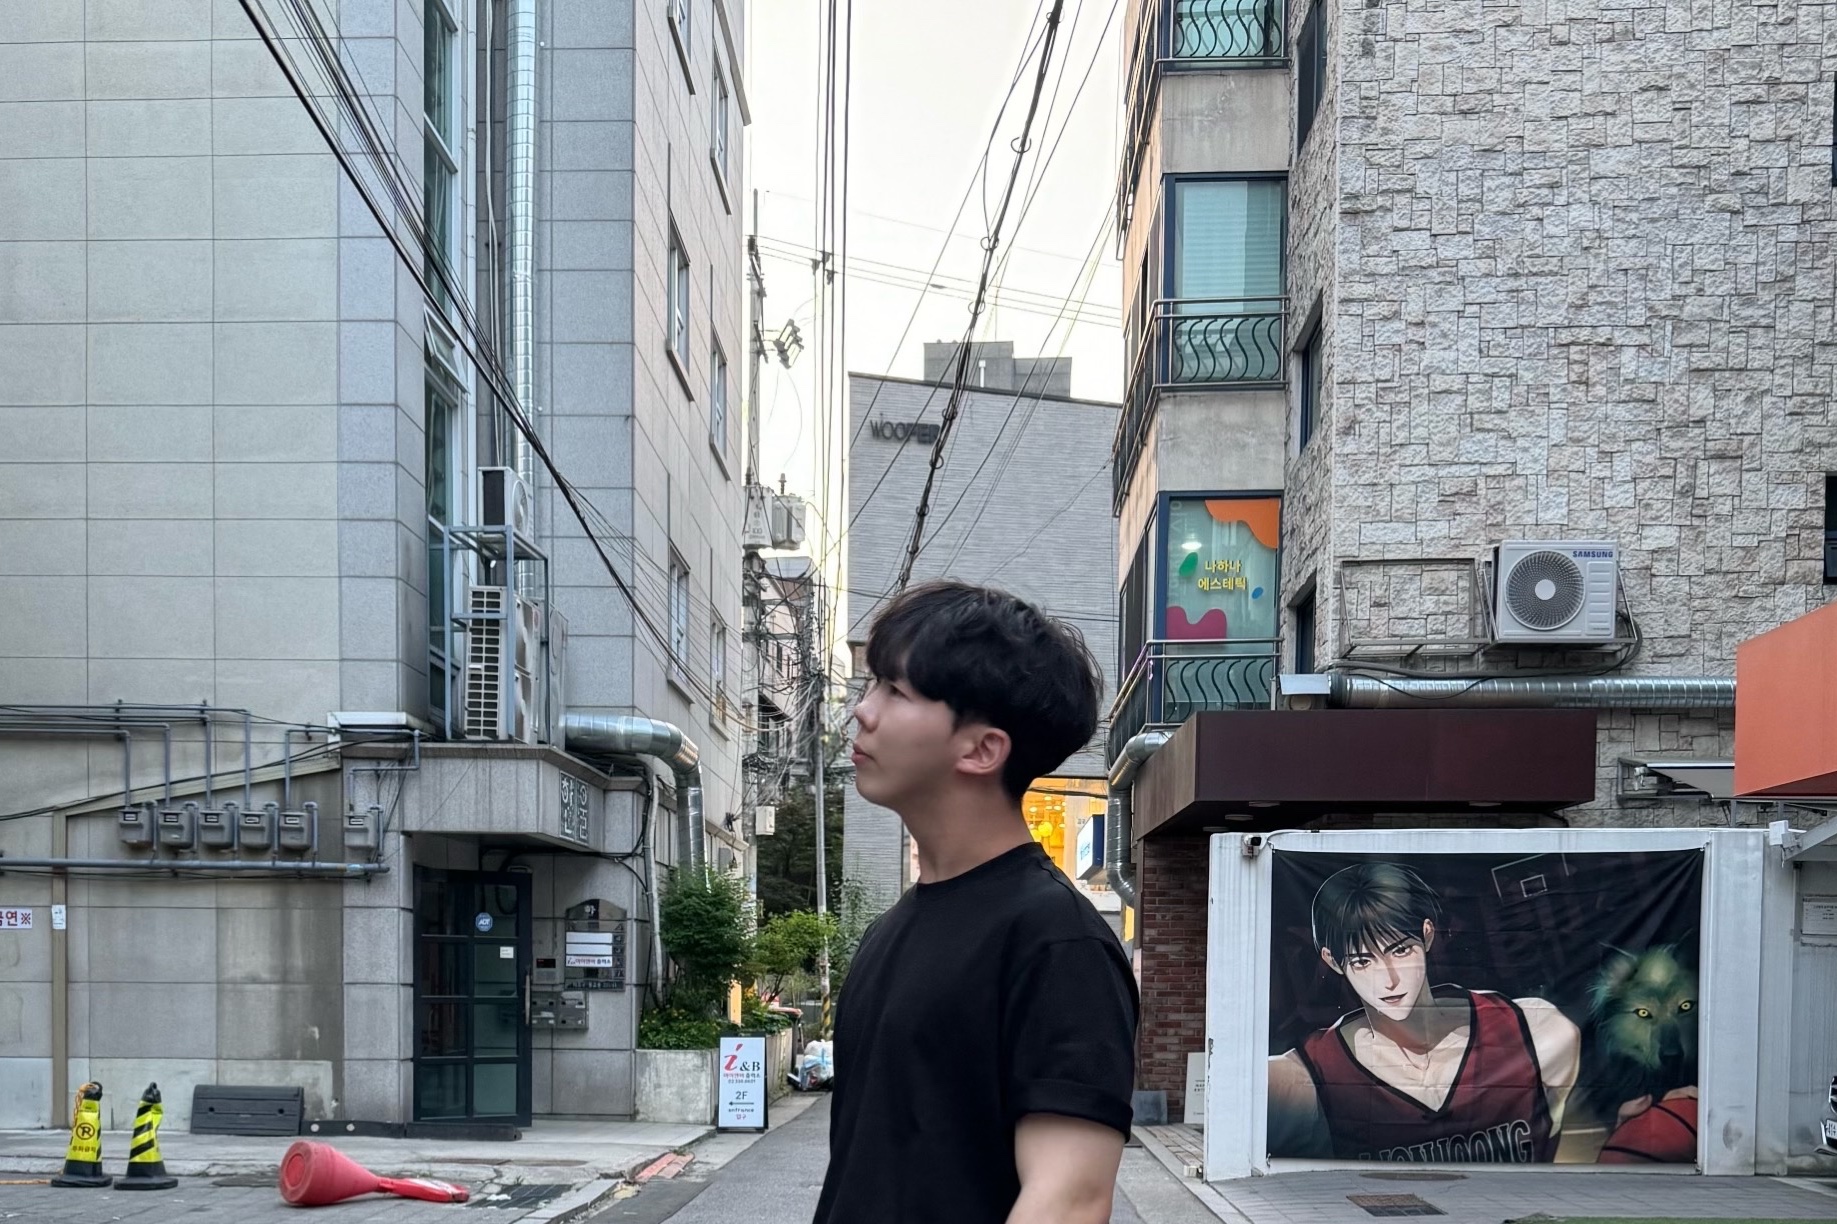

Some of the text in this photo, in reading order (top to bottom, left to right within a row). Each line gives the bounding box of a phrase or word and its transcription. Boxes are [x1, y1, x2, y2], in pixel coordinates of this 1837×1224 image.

[1204, 560, 1241, 573] 나하나
[1198, 577, 1247, 591] 에스테틱
[735, 1091, 748, 1100] 2F
